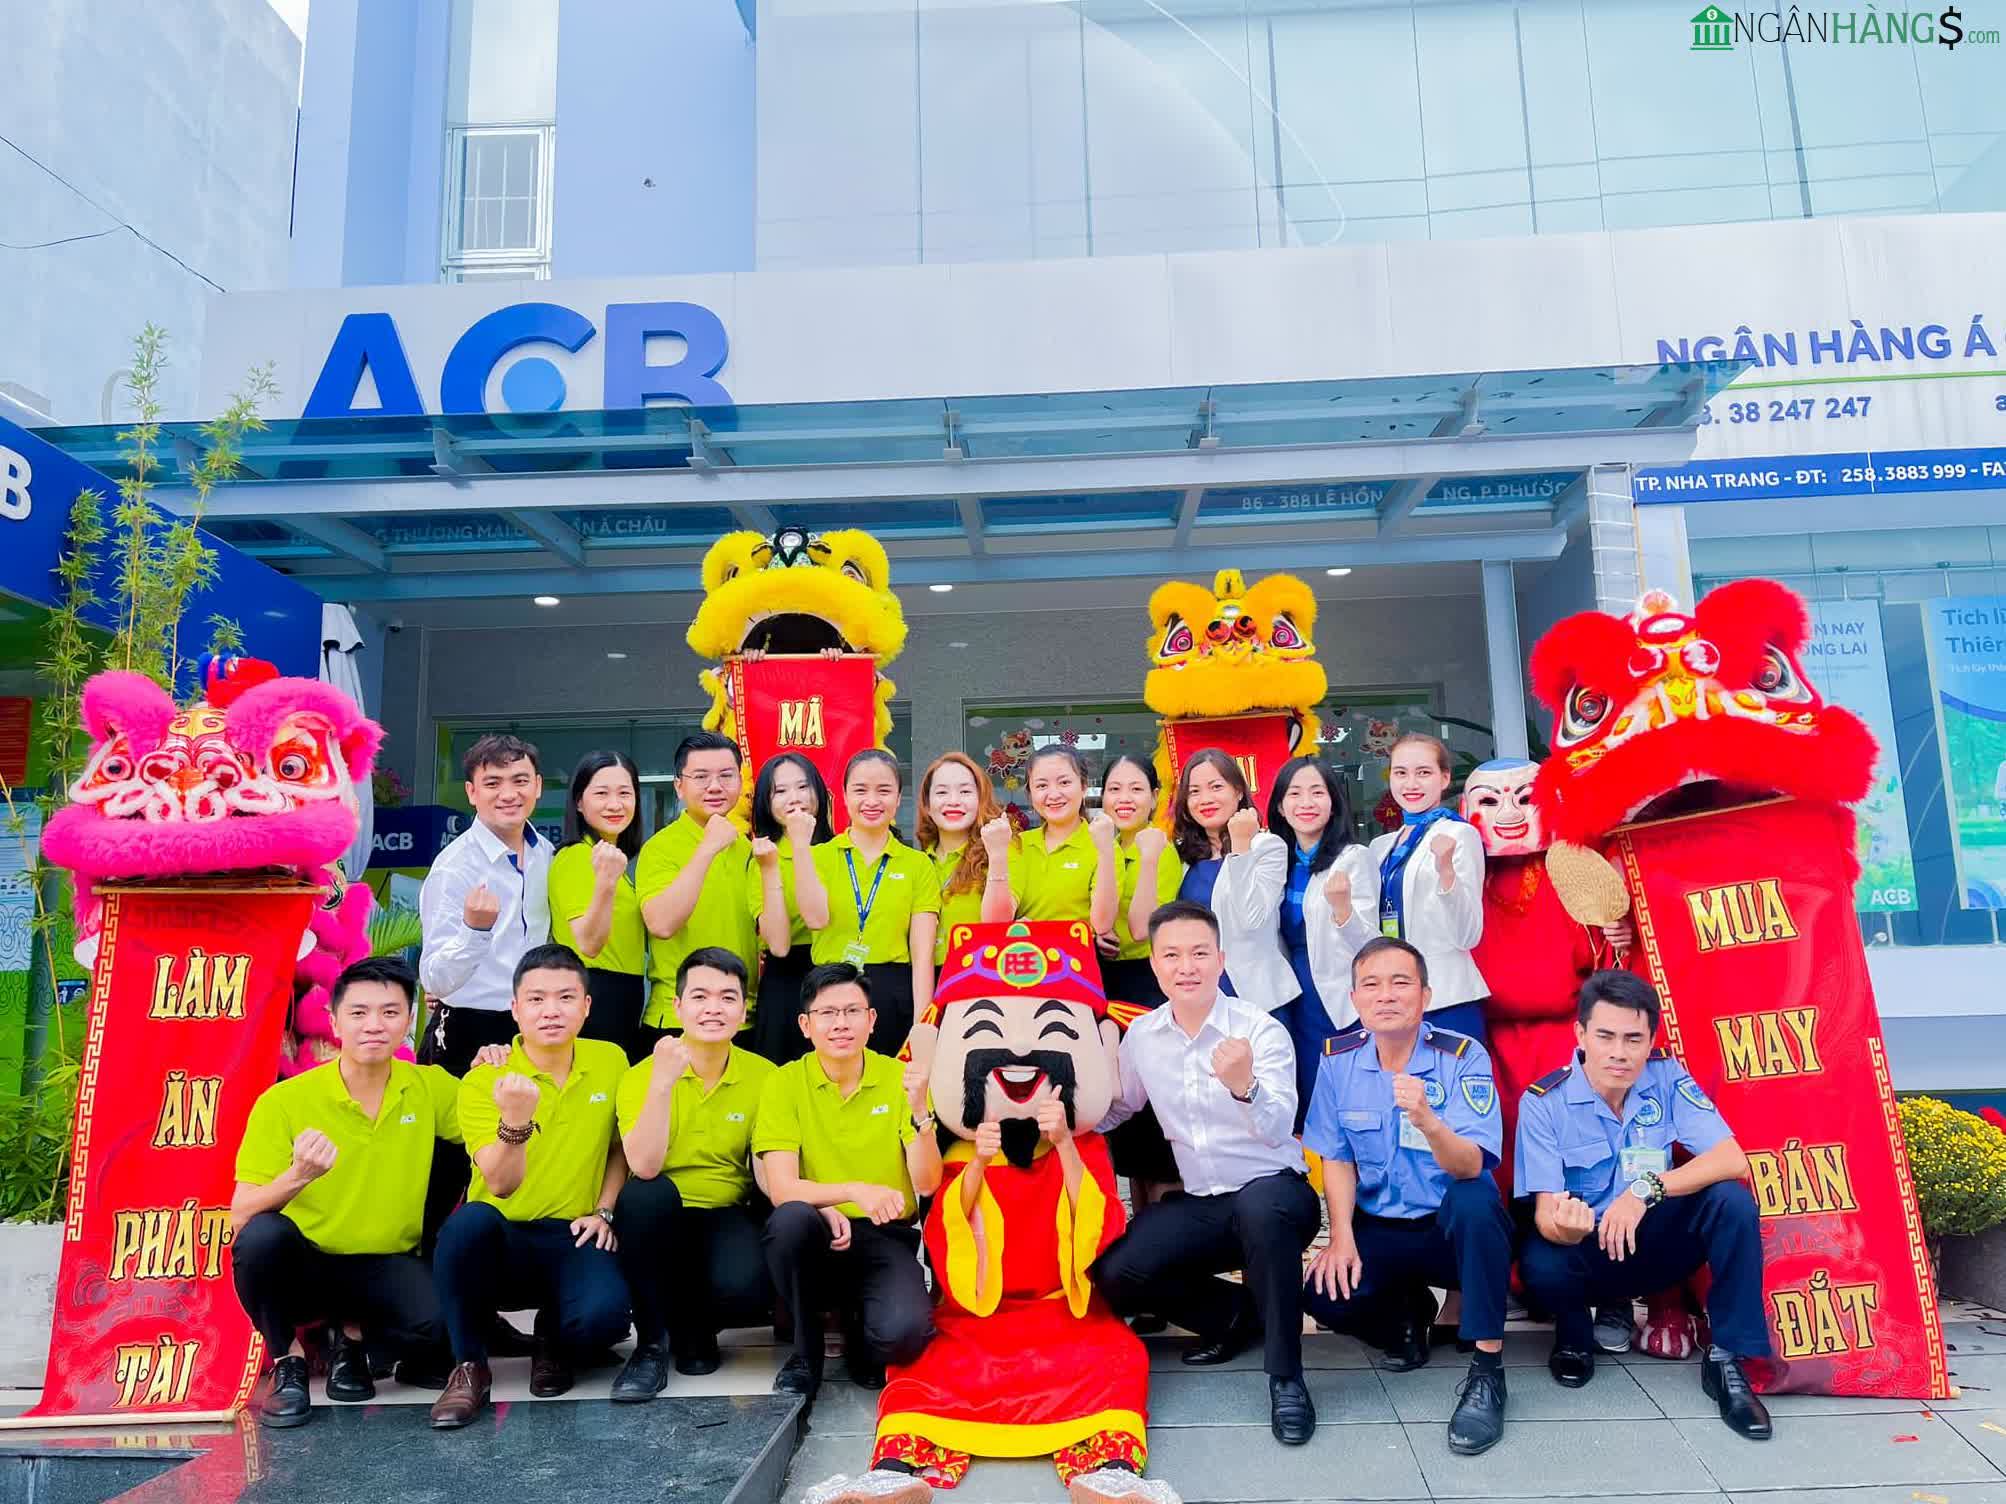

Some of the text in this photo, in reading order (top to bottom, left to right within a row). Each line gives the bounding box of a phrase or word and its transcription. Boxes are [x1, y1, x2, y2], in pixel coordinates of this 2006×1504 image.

[292, 301, 739, 432] ACB
[1656, 313, 1998, 371] NGÂN HÀNG Á
[1728, 401, 1761, 424] 38
[1768, 399, 1815, 422] 247
[1825, 396, 1872, 419] 247
[0, 444, 32, 521] B
[1635, 476, 1662, 492] TP.
[1665, 475, 1709, 491] NHA
[1712, 472, 1780, 488] TRANG
[1795, 468, 1827, 485] ĐT:
[1932, 463, 1967, 480] 999
[1981, 460, 2006, 477] FA
[1831, 621, 1865, 635] NAY
[1840, 640, 1868, 655] LAI
[372, 832, 414, 851] ACB
[1686, 878, 1799, 951] MUA
[1870, 888, 1911, 905] ACB
[149, 947, 250, 1019] LÀM
[1713, 1007, 1822, 1081] MAY
[152, 1070, 222, 1148] ĂN
[1747, 1139, 1857, 1217] BÁN
[109, 1199, 233, 1281] PHÁT
[1771, 1270, 1877, 1358] ĐẮT
[112, 1334, 201, 1408] TÀI
